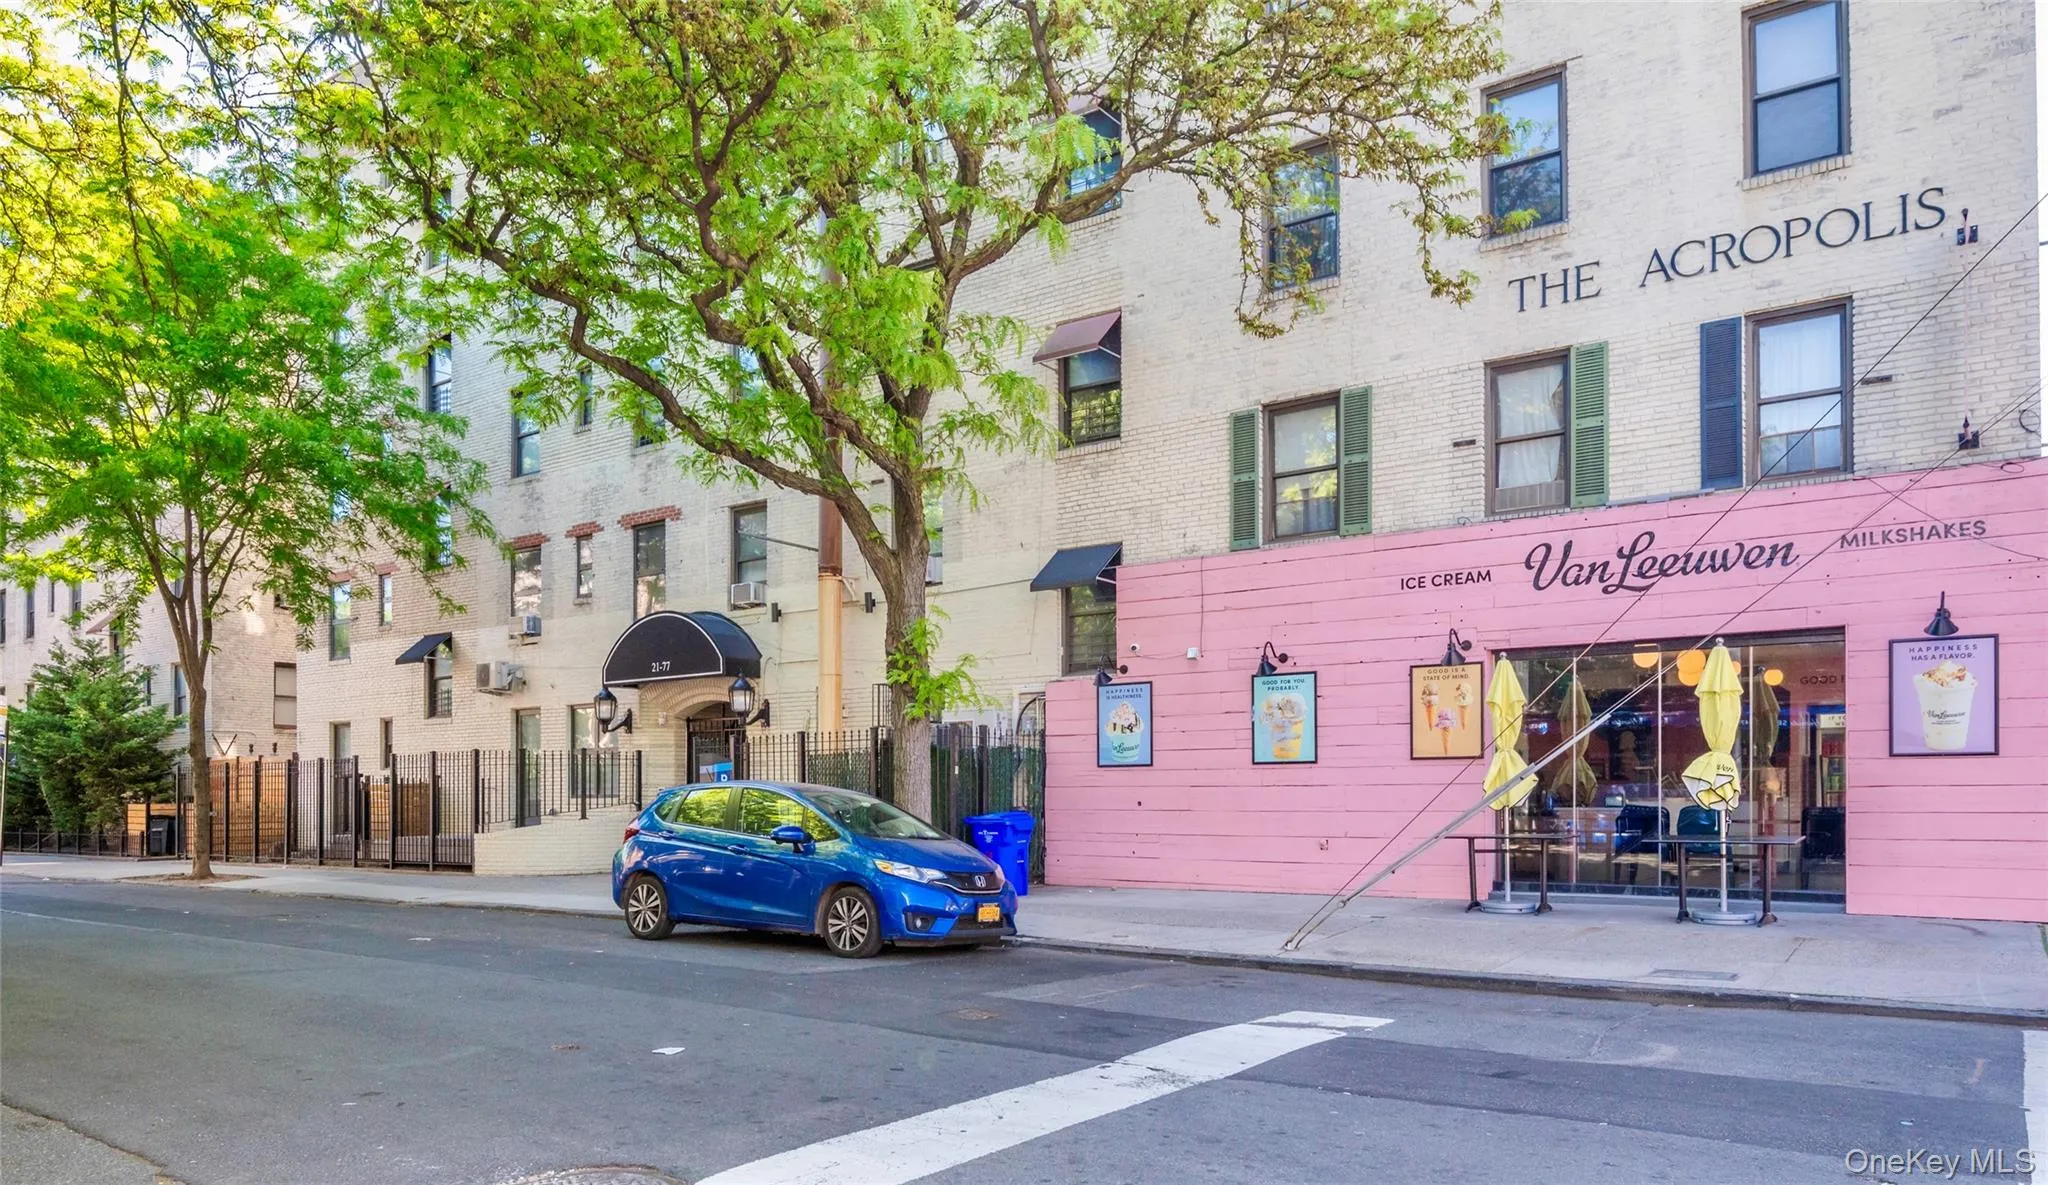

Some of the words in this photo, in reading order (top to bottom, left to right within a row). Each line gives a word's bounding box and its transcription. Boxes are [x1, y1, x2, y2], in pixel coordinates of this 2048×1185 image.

[1508, 261, 1602, 313] THE
[1639, 187, 1946, 288] ACROPOLIS
[1840, 520, 1986, 549] MILKSHAKES
[1524, 540, 1615, 591] Van
[1602, 531, 1800, 595] Leeuwen
[1401, 576, 1426, 590] ICE
[1431, 569, 1491, 587] CREAM
[1908, 643, 1978, 653] HAPPINESS
[1939, 652, 1975, 660] FLAVOR.
[651, 661, 671, 672] 21-77
